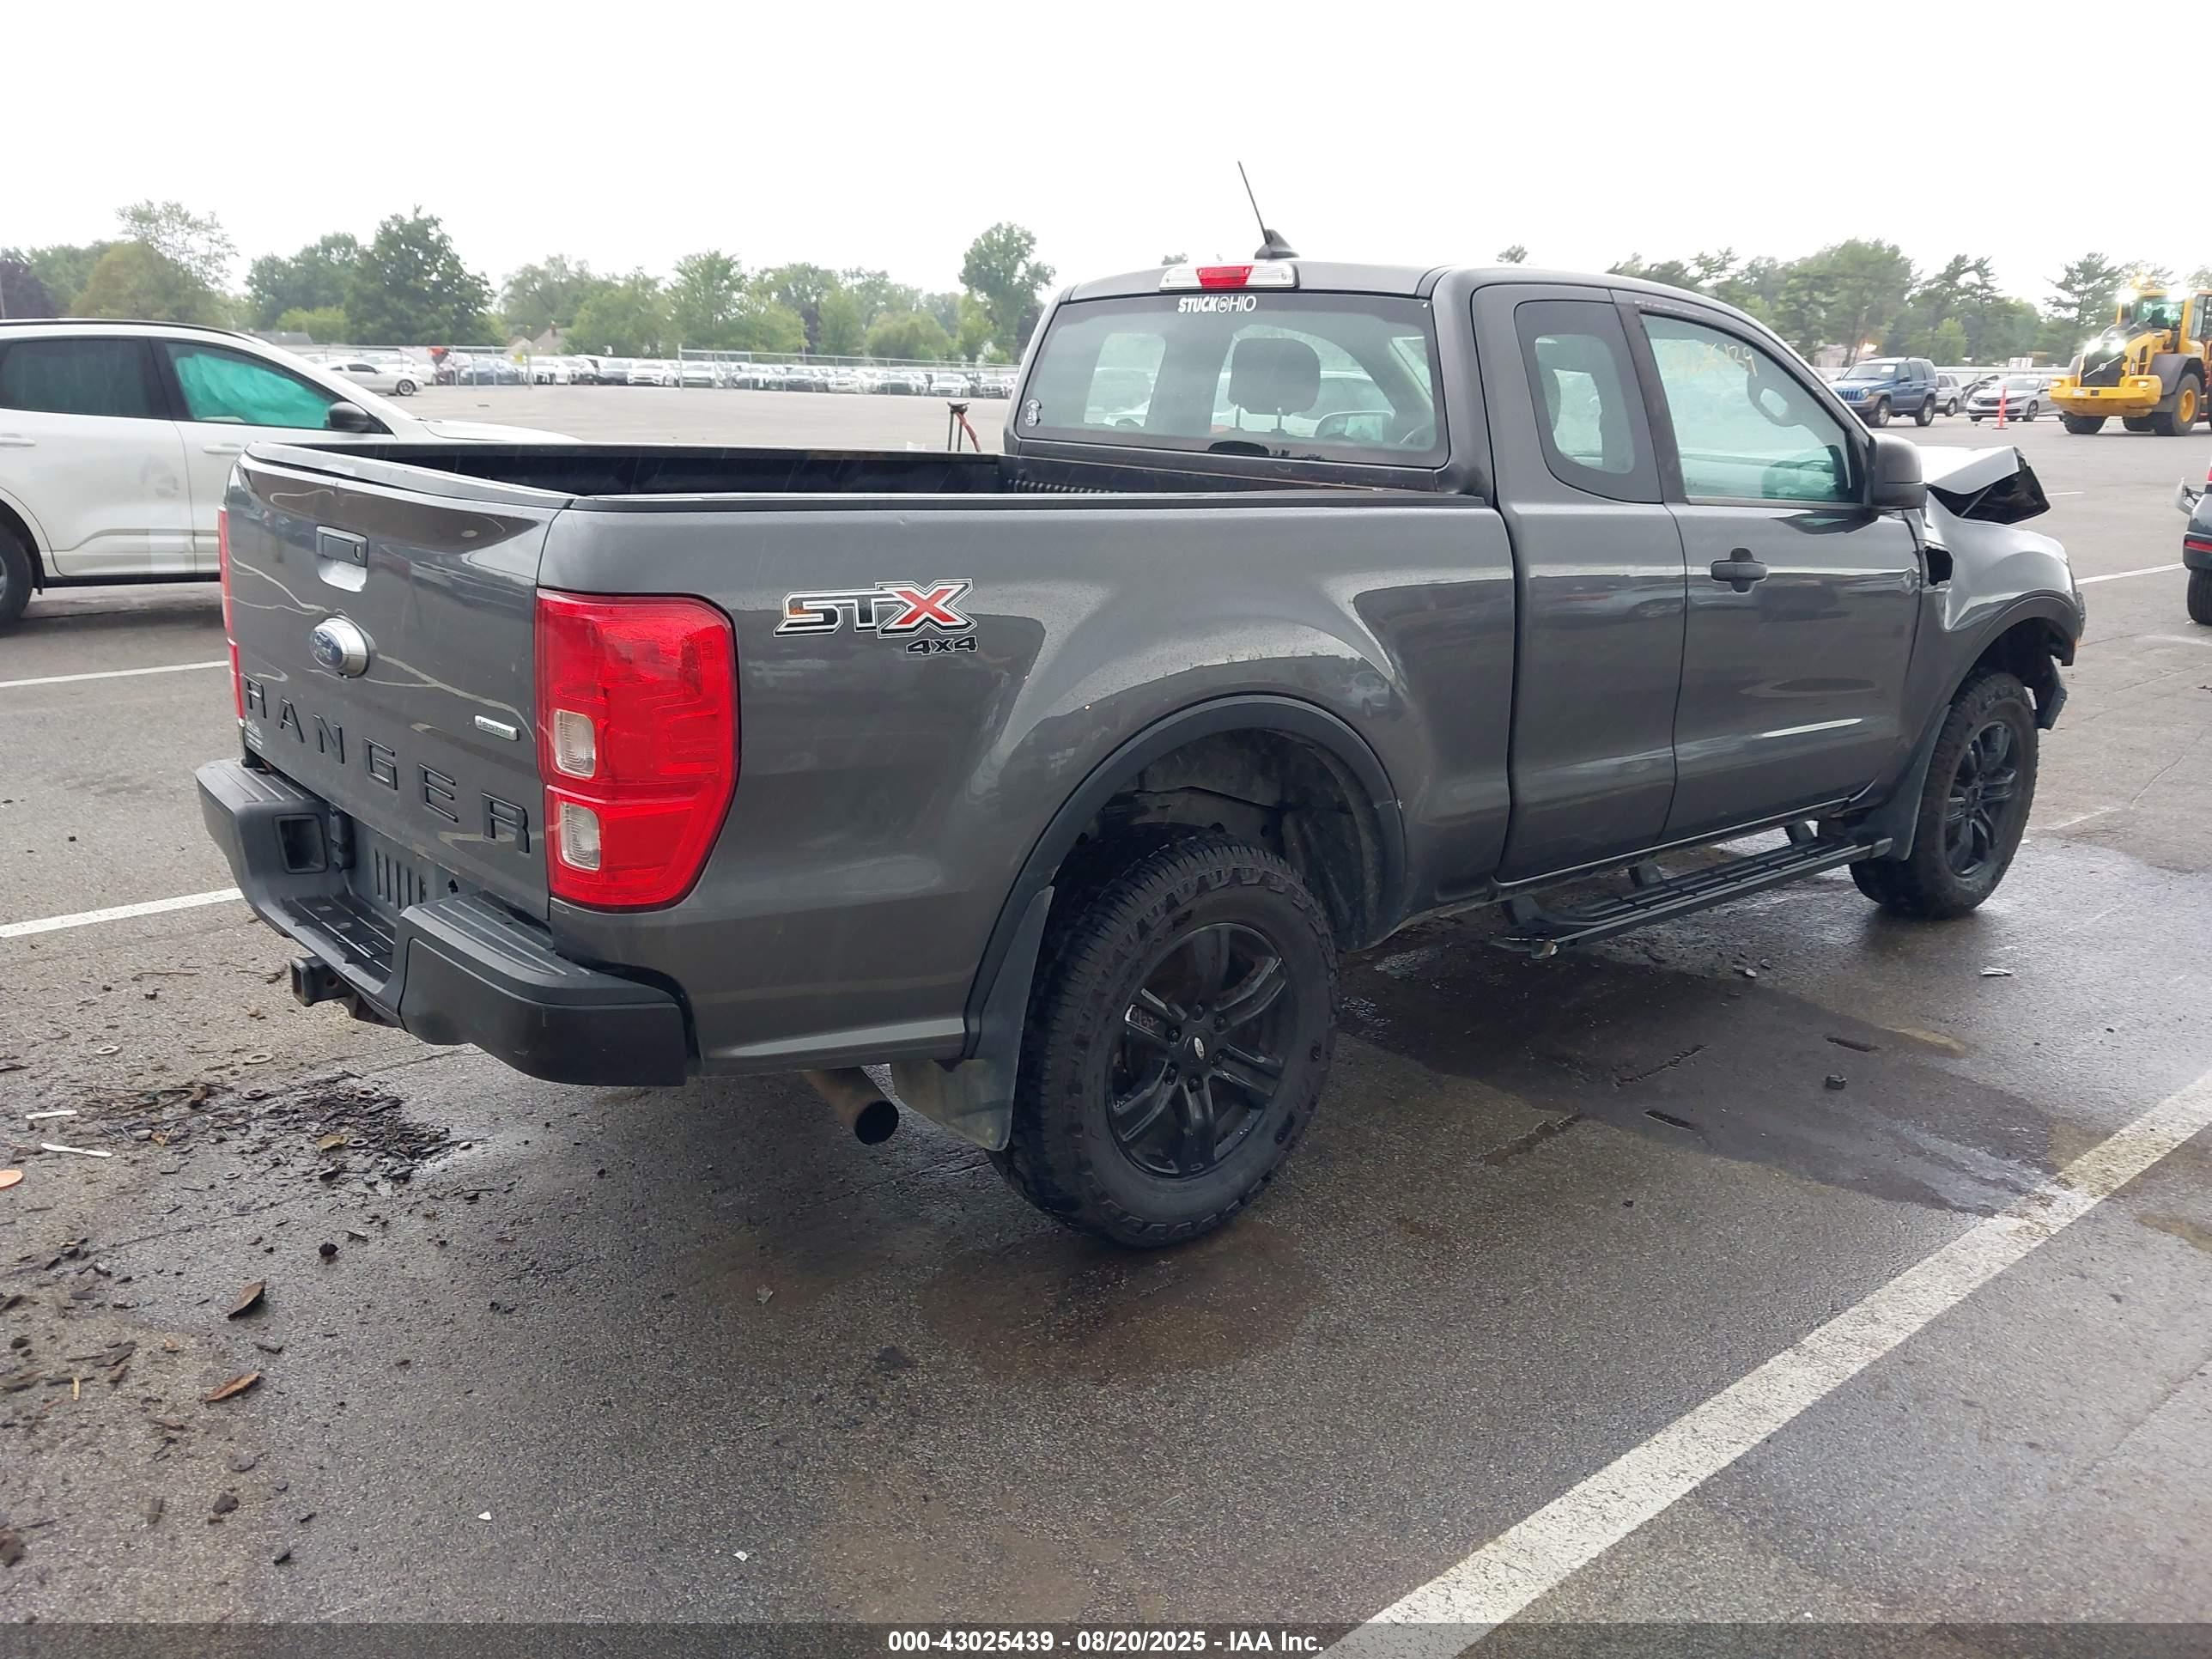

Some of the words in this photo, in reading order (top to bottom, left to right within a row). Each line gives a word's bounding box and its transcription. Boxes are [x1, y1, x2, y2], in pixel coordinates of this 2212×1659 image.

[1177, 296, 1218, 313] STUCK
[773, 578, 977, 639] STX
[244, 675, 531, 854] RANGER
